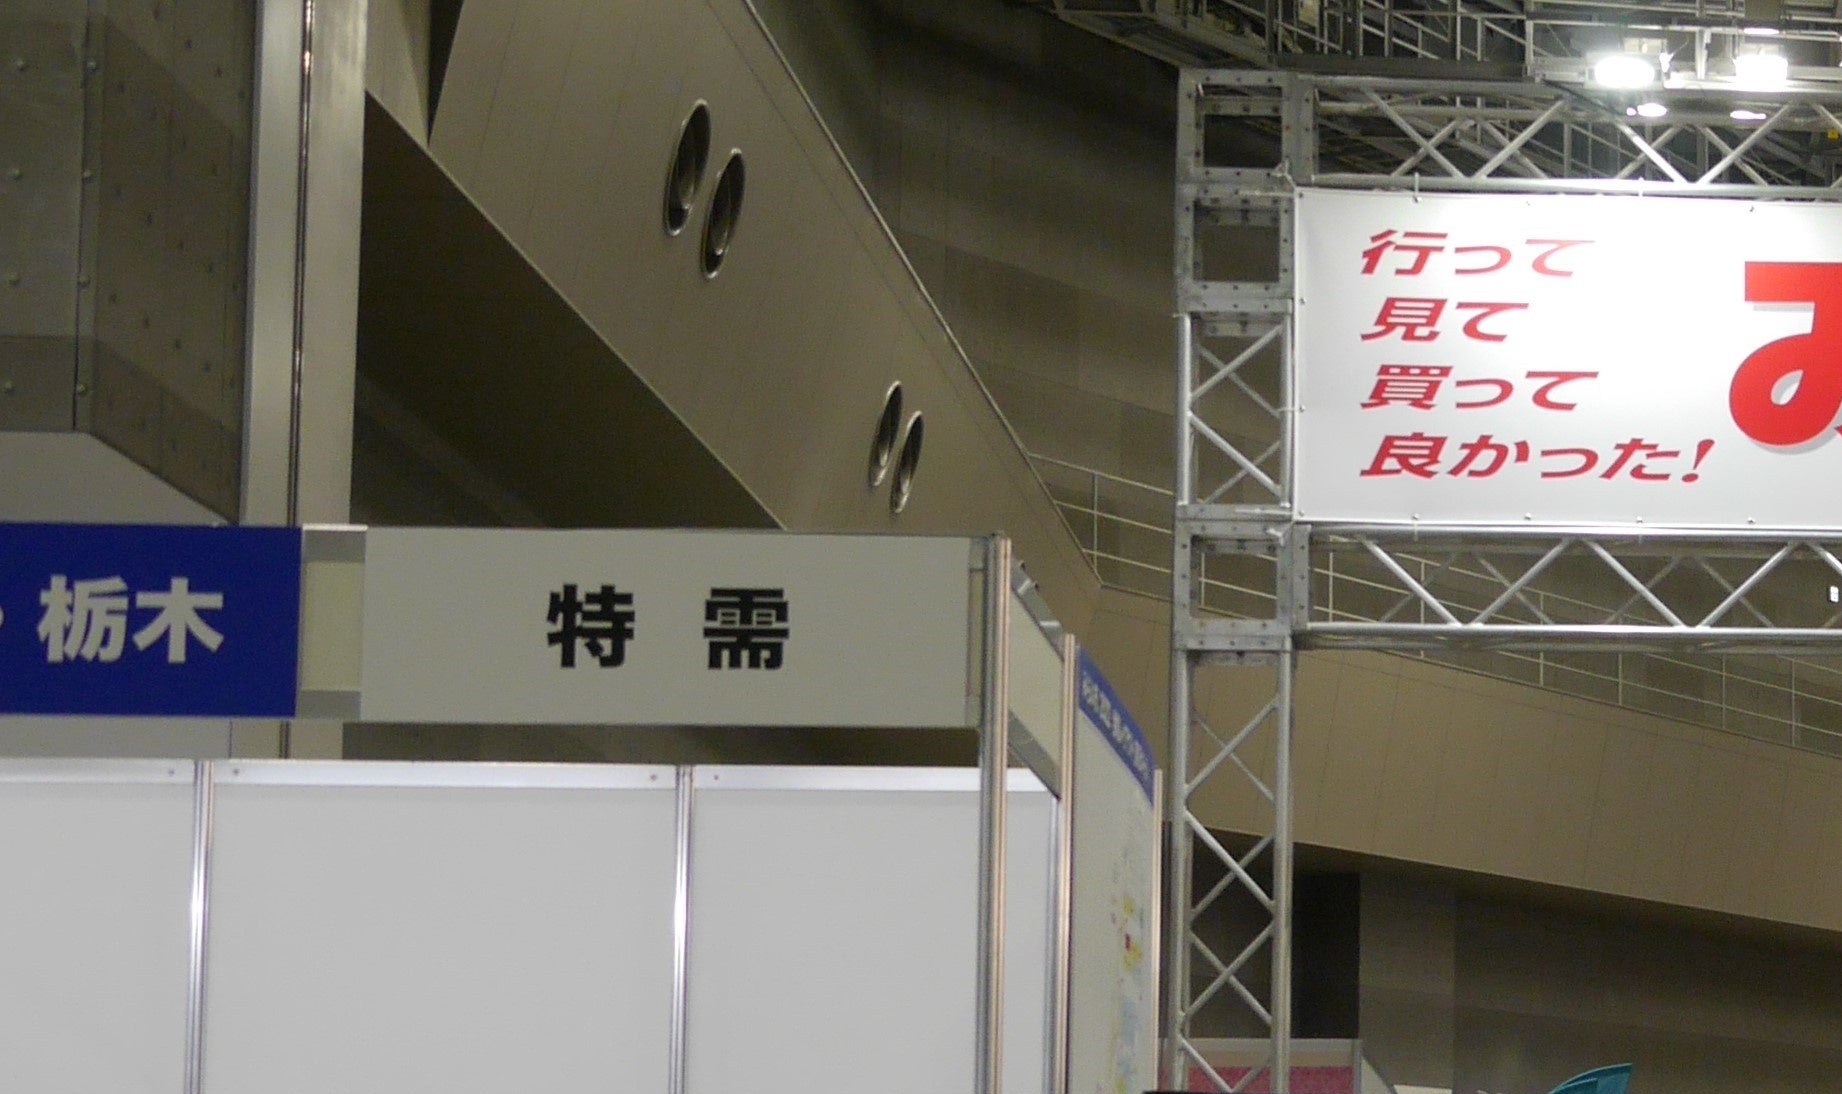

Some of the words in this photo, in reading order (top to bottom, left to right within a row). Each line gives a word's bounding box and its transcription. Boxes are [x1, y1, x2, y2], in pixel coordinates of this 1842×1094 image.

[1361, 228, 1595, 277] 行って
[1360, 296, 1529, 343] 見て
[1361, 363, 1599, 412] 買って
[1360, 431, 1716, 484] 良かった!
[37, 575, 224, 663] 栃木
